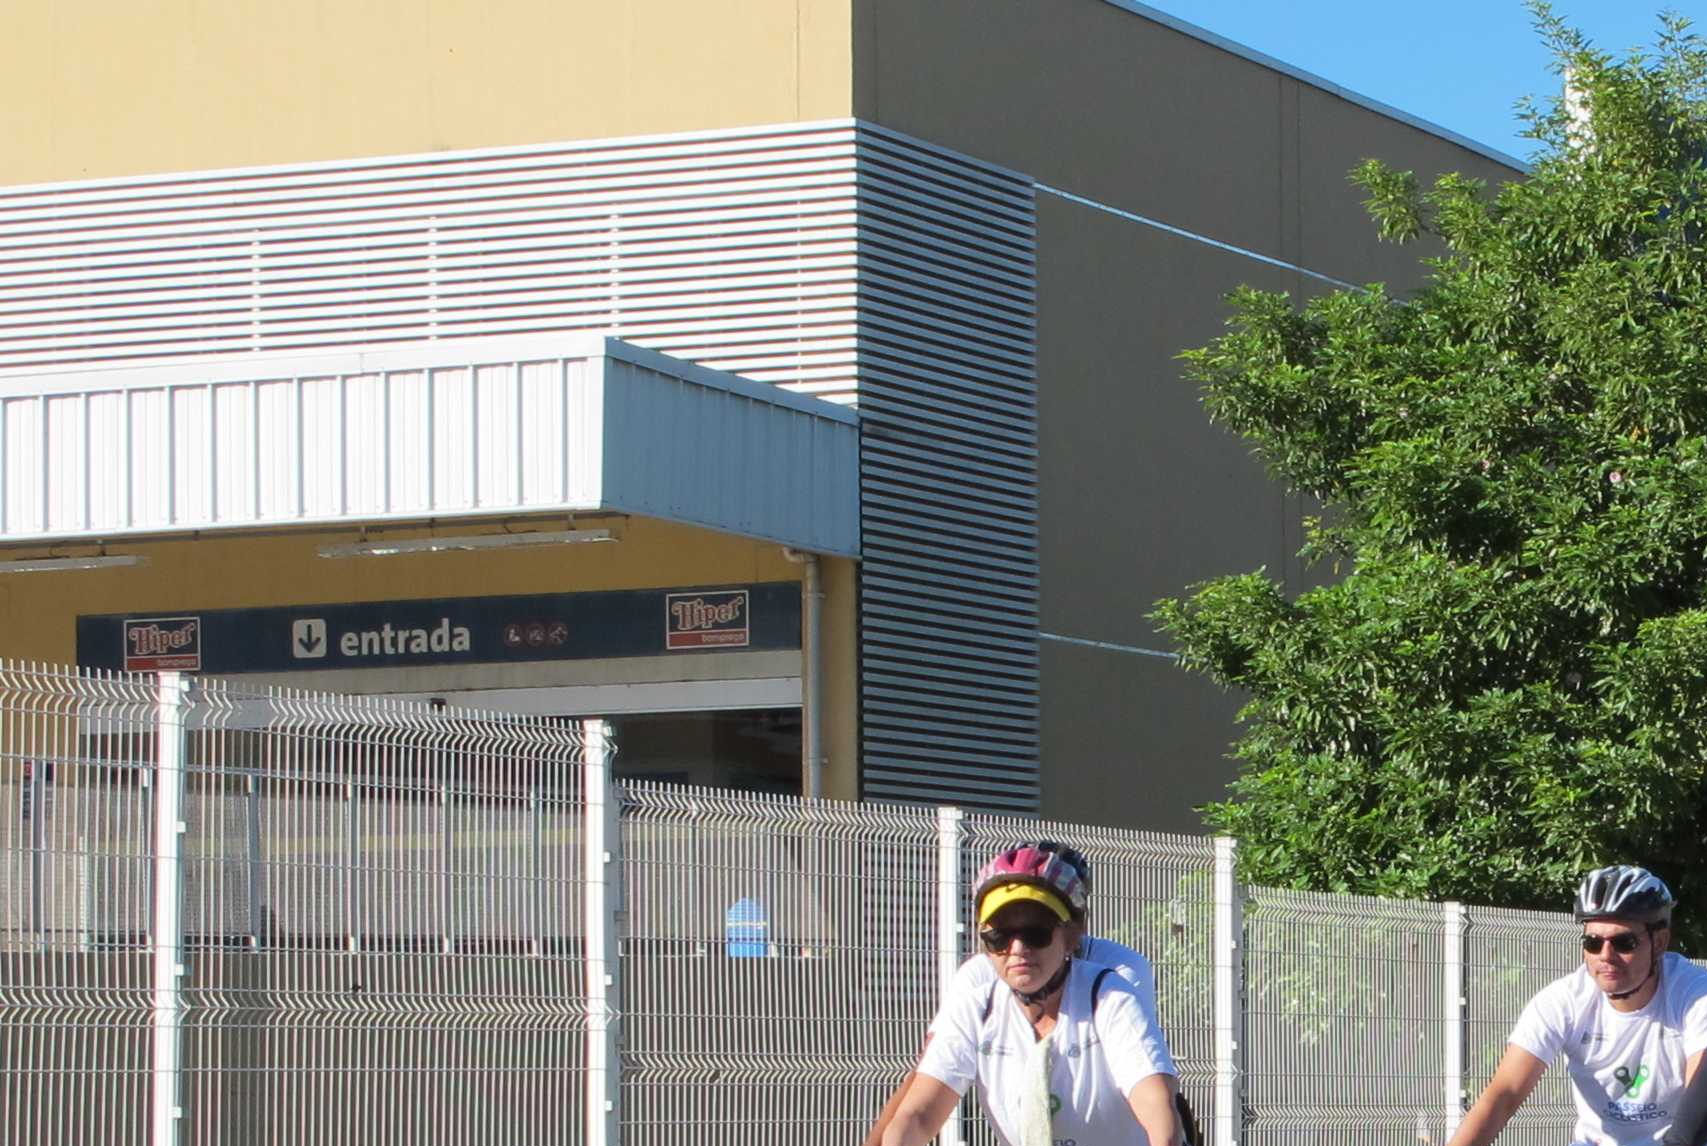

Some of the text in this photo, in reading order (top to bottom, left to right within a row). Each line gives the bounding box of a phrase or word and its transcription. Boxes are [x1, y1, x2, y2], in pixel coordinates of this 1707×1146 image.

[671, 596, 744, 630] Hiper
[128, 622, 196, 655] Hiper
[340, 618, 471, 657] entrada
